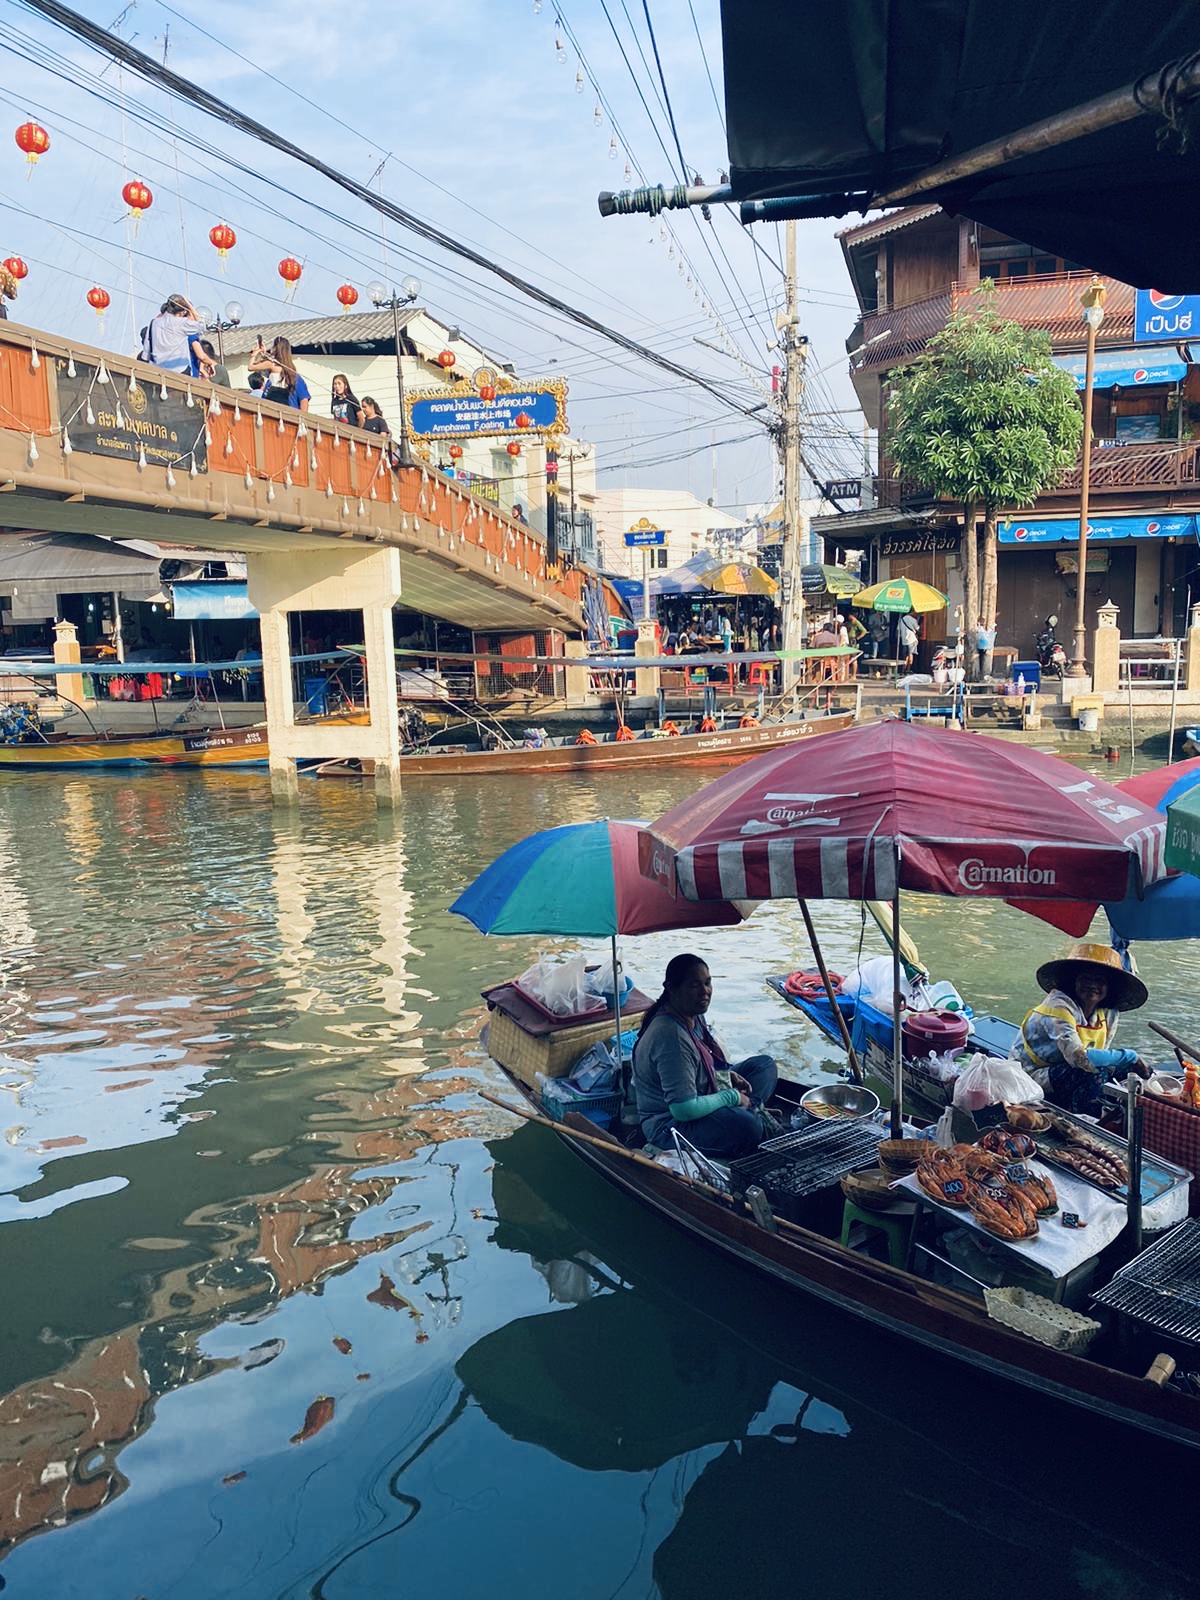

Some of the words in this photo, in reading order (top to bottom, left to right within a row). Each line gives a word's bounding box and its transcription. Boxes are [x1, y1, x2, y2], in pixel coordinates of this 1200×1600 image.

[1145, 311, 1192, 333] เป๊ปซี่
[1149, 370, 1169, 378] pepsi
[432, 422, 471, 434] Amphawa
[474, 420, 505, 431] Foating
[830, 483, 859, 497] ATM
[1093, 526, 1112, 534] pepsi
[1161, 523, 1182, 531] pepsi
[958, 858, 1056, 890] Carnation
[943, 1180, 963, 1193] 400
